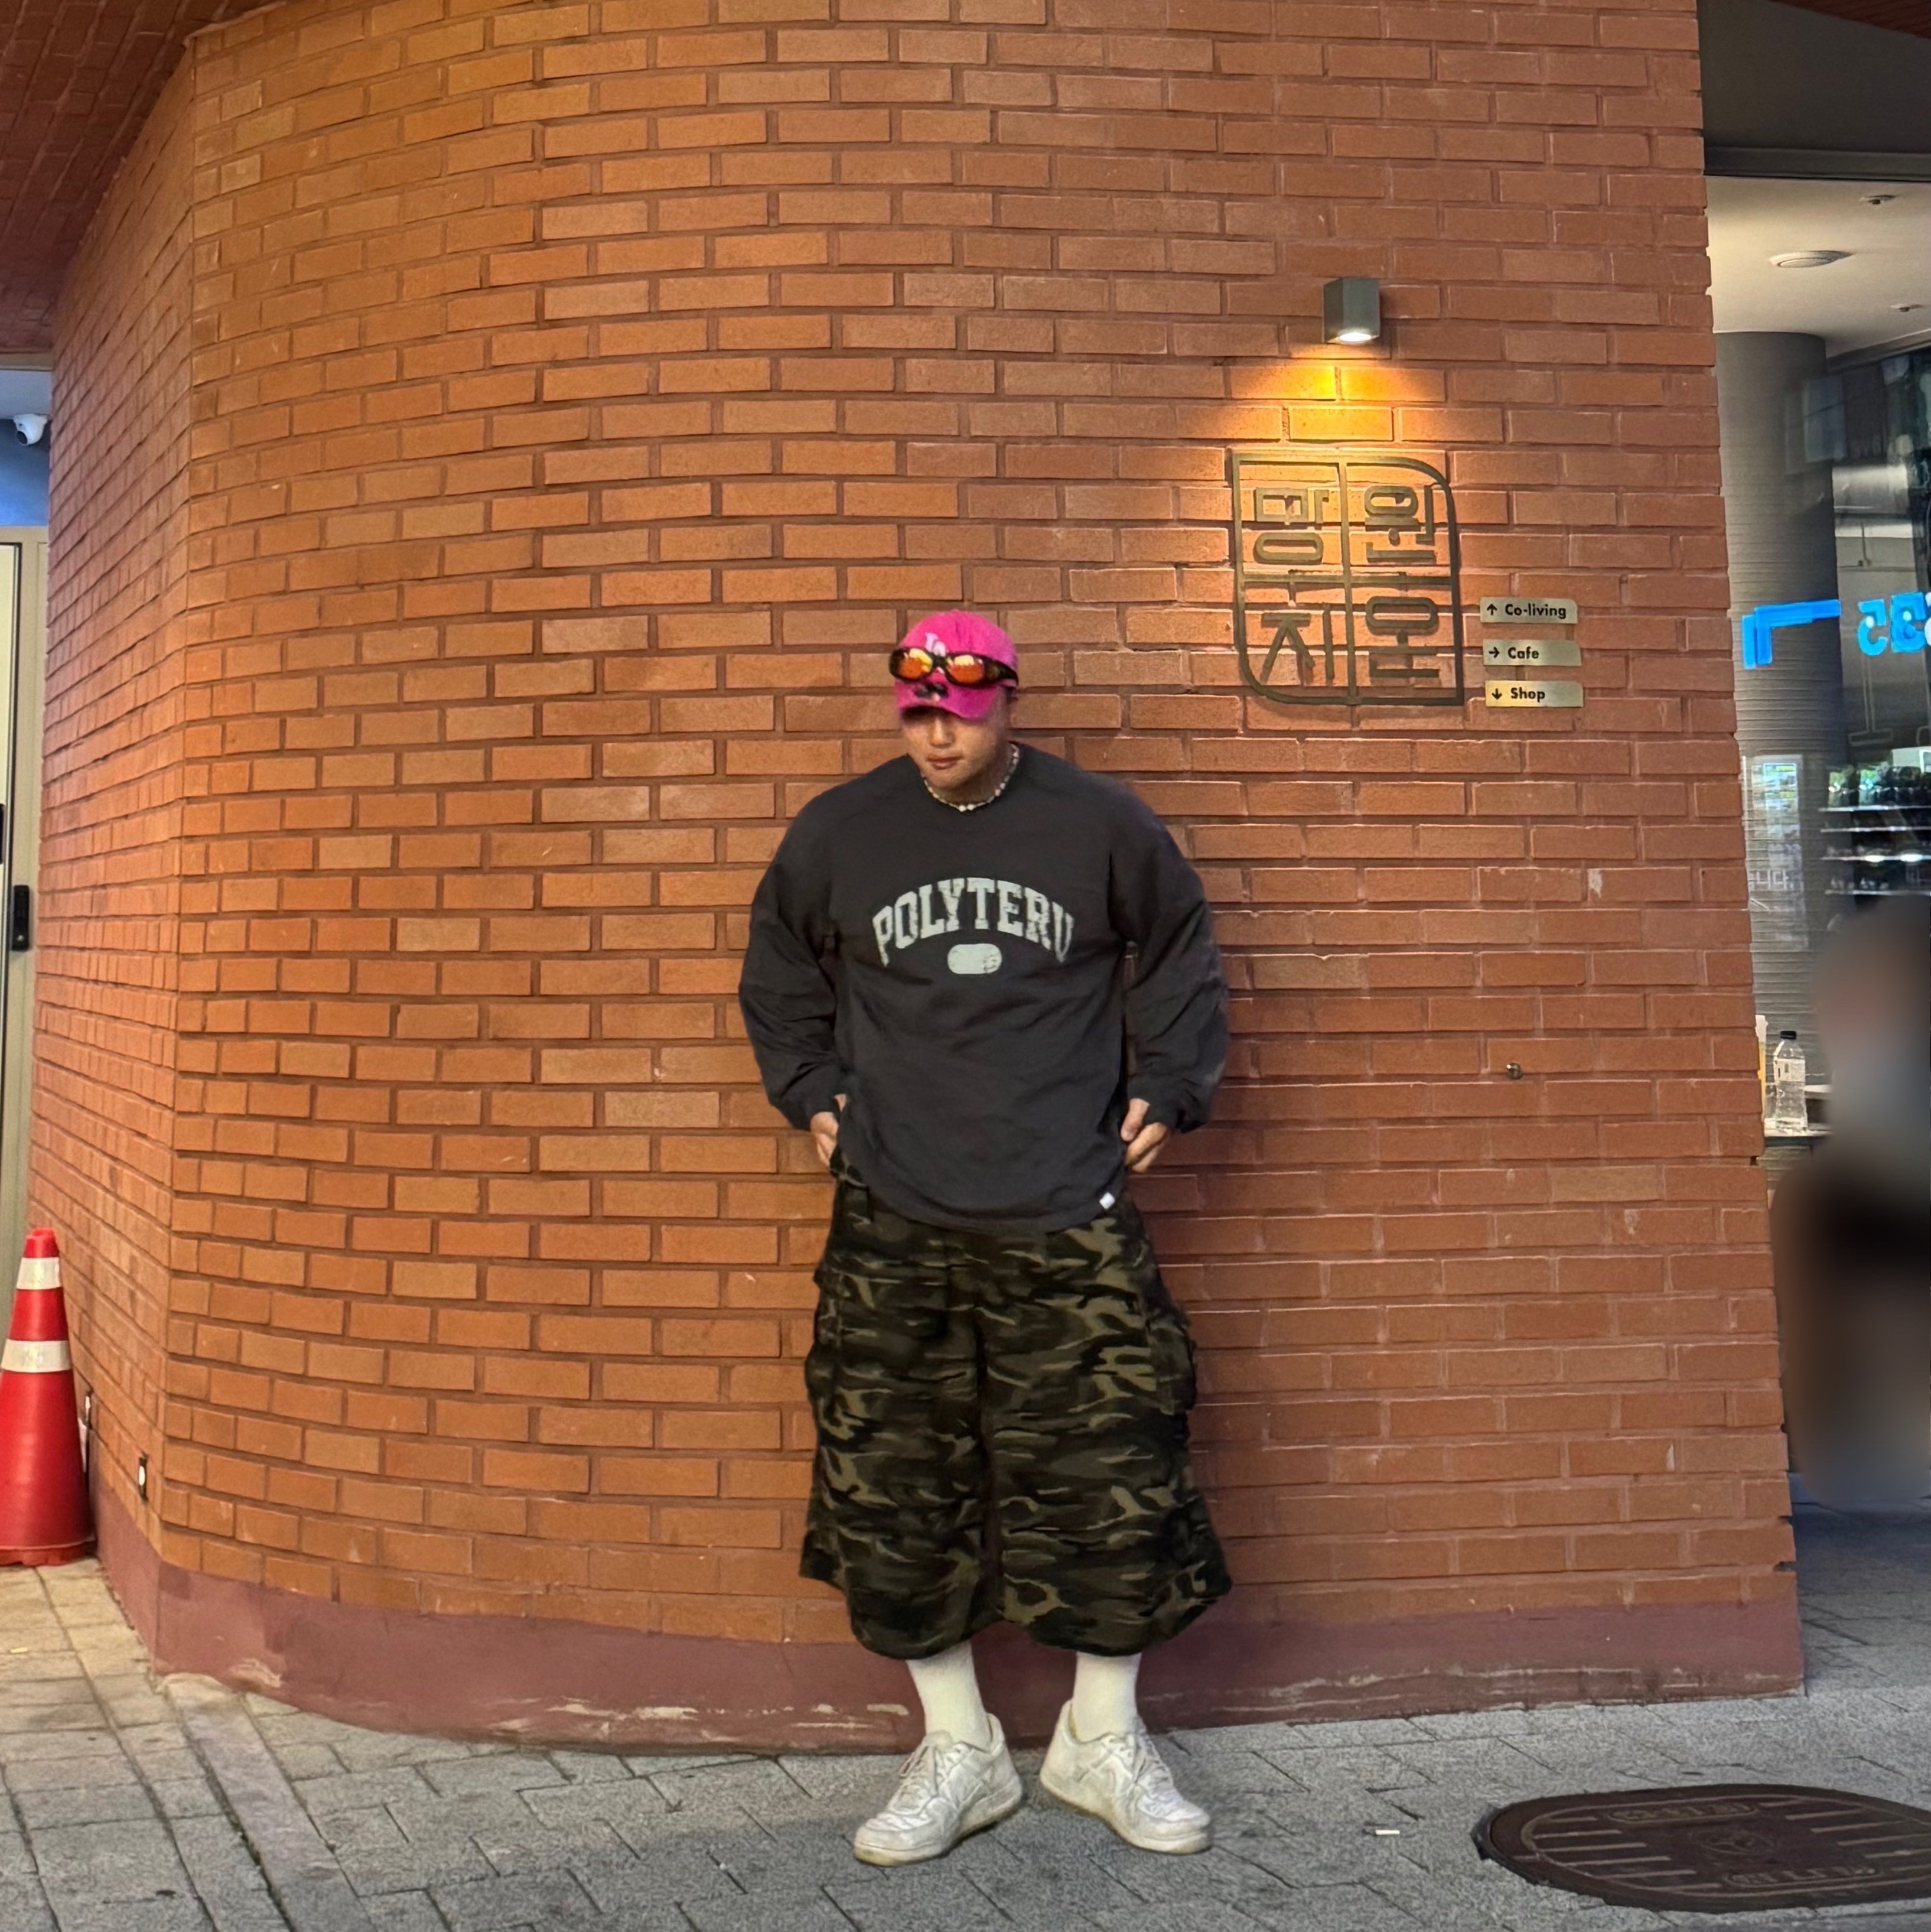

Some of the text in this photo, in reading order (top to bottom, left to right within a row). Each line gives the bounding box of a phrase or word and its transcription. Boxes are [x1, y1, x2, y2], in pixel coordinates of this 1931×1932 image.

[1505, 603, 1567, 619] Co-living
[1507, 646, 1539, 659] Cafe
[1510, 687, 1545, 702] Shop
